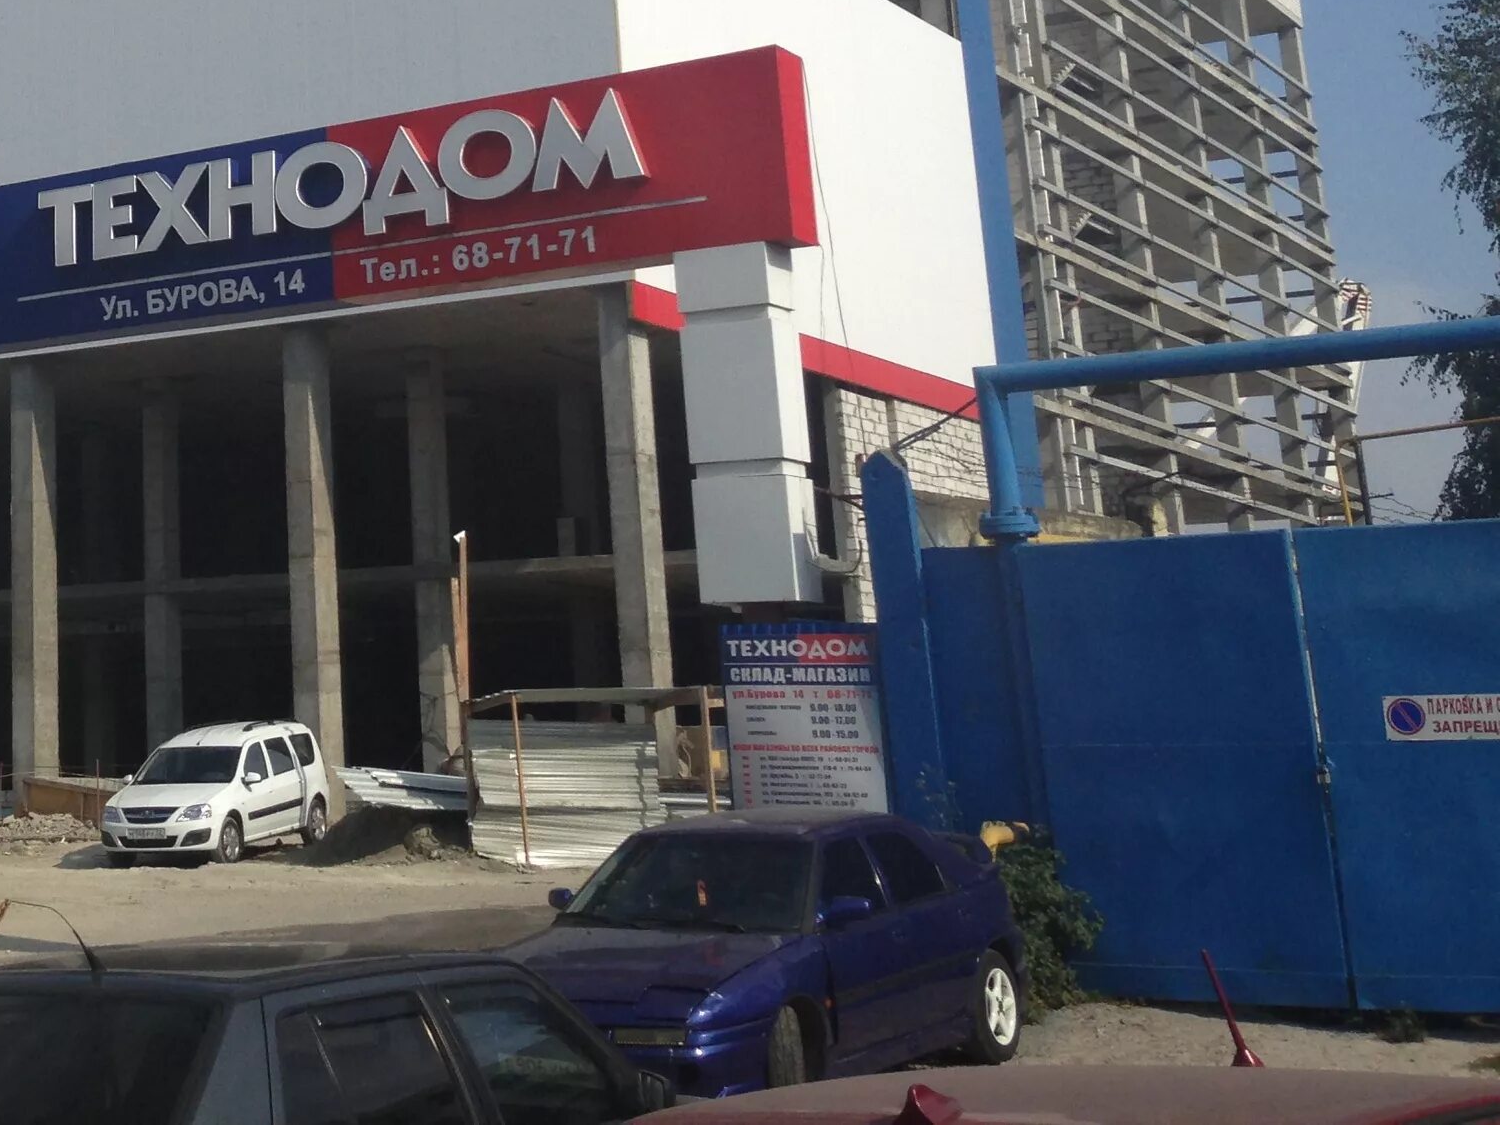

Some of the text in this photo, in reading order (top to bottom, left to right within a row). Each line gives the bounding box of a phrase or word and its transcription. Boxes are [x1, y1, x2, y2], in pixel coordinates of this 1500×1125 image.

[38, 87, 650, 267] ТЕХНОДОМ
[360, 225, 596, 284] Тел.: 68-71-71
[100, 268, 305, 321] Ул. БУРОВА, 14
[726, 639, 870, 659] ТЕХНОДОМ
[730, 667, 871, 684] СКЛАД-МАГАЗИН
[1427, 697, 1483, 714] ПАРКОВКА
